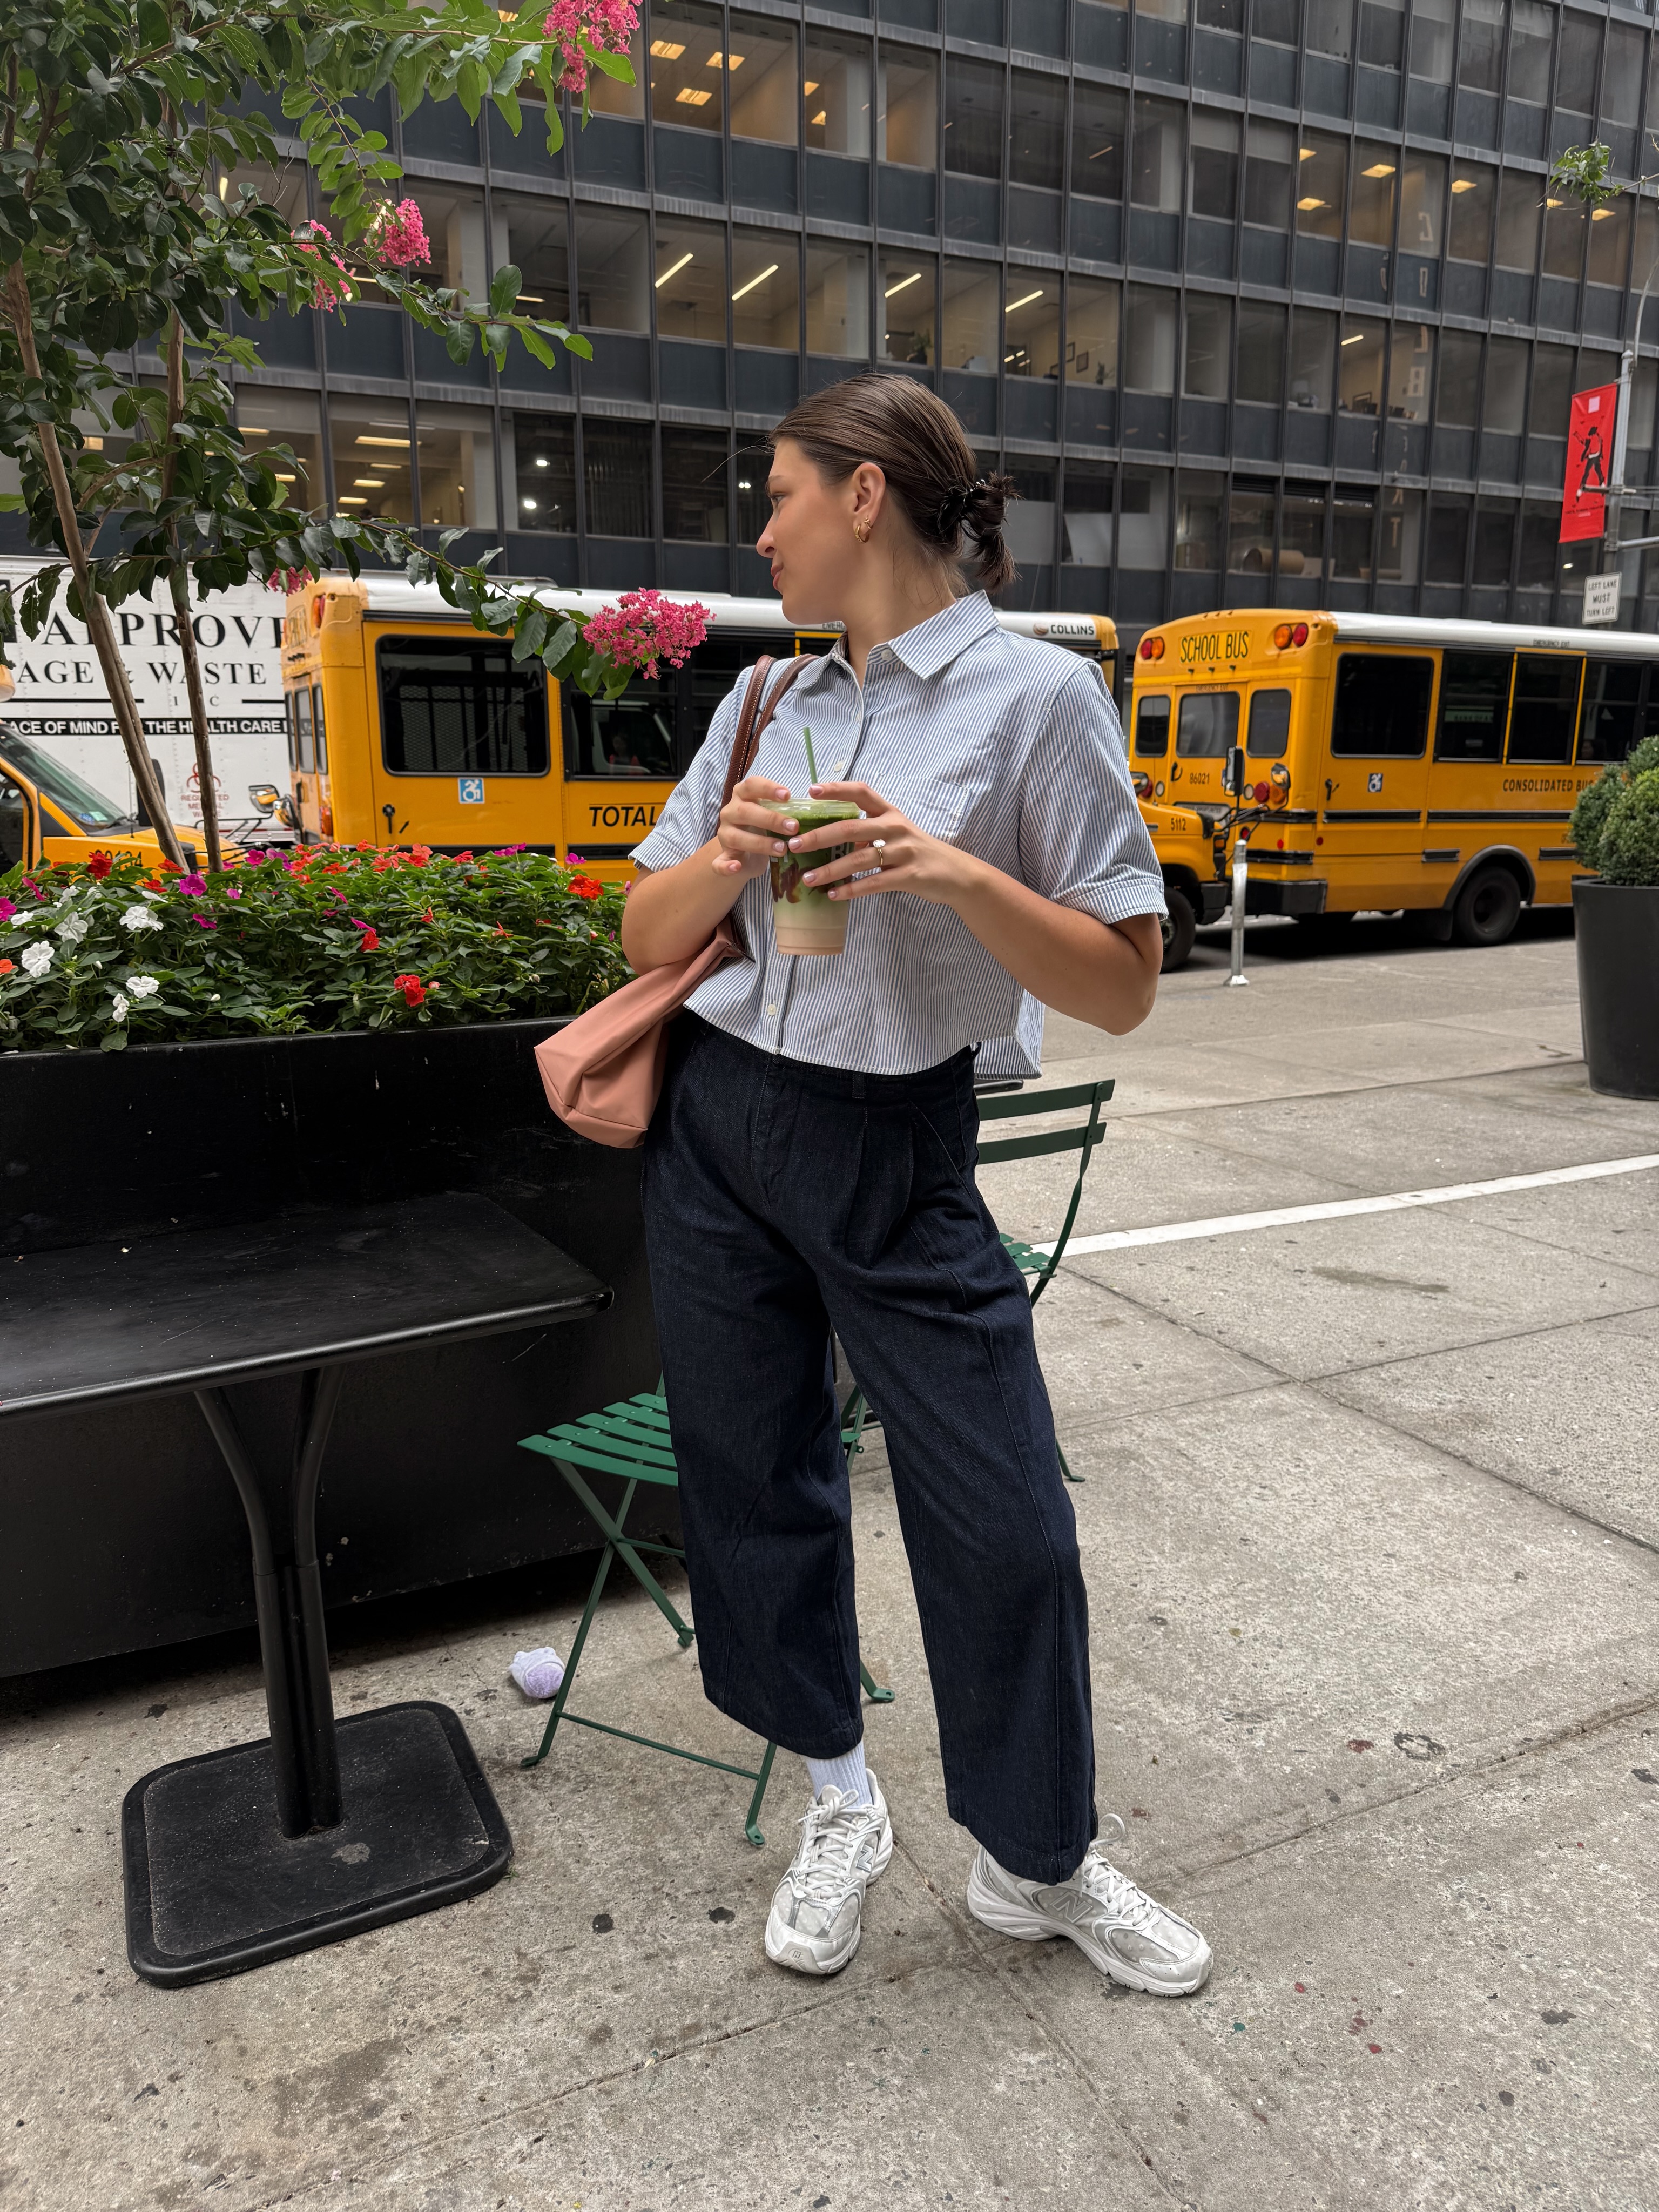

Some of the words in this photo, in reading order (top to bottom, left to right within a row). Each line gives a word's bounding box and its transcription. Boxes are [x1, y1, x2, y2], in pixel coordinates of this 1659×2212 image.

[1588, 582, 1601, 591] LEFT
[1603, 579, 1617, 590] LANE
[1593, 592, 1611, 604] MUST
[1587, 608, 1599, 617] TURN
[1602, 606, 1615, 616] LEFT
[1051, 625, 1094, 635] COLLINS
[1180, 635, 1222, 663] SCHOOL
[1225, 631, 1249, 658] BUS
[146, 662, 266, 684] WSTE
[44, 721, 66, 734] OF
[70, 721, 108, 734] MIND
[145, 721, 177, 733] THE
[240, 720, 281, 732] CARE
[1189, 773, 1210, 784] 86021
[1503, 779, 1573, 792] CONSOLIDATED
[589, 806, 657, 827] TOTAL
[1171, 818, 1186, 831] 5112
[1050, 1891, 1093, 1923] N
